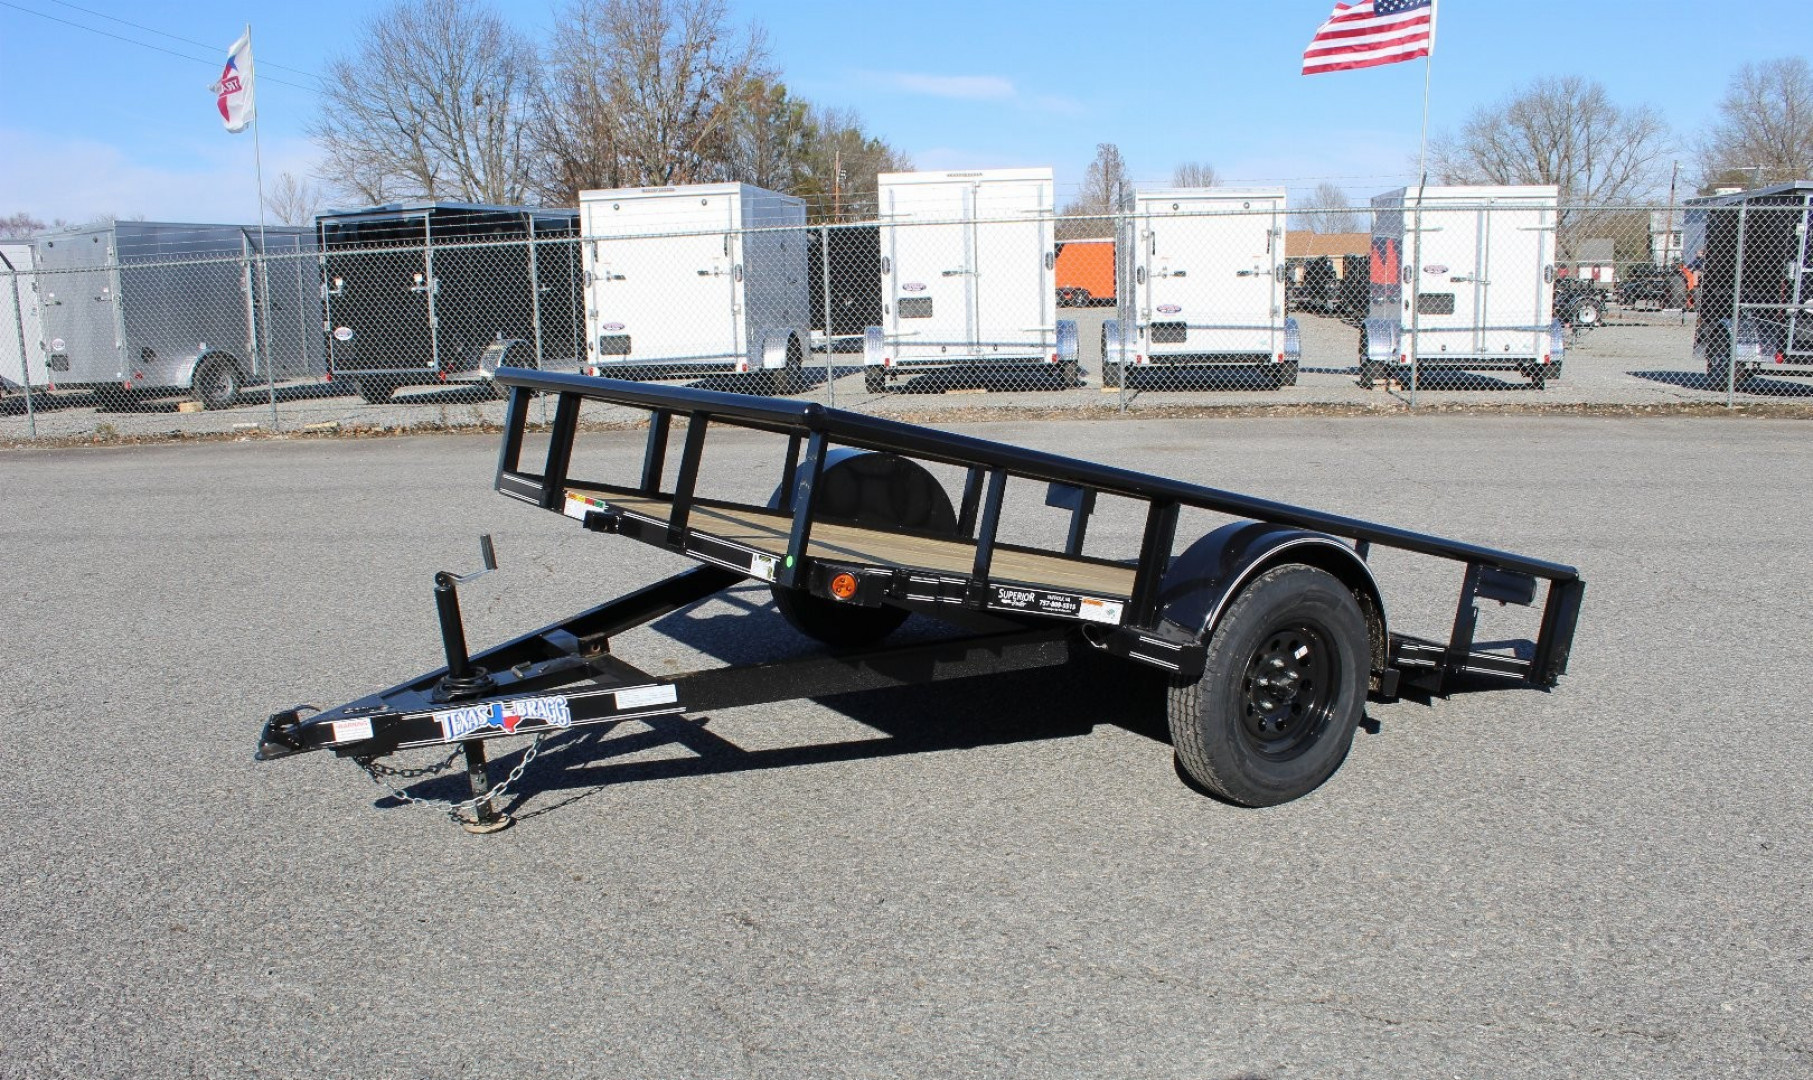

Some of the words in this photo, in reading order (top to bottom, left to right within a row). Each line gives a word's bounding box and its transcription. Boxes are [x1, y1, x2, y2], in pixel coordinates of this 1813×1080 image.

[997, 588, 1035, 603] SUPERIOR
[433, 705, 488, 741] TEXAS
[514, 695, 571, 726] BRAGG
